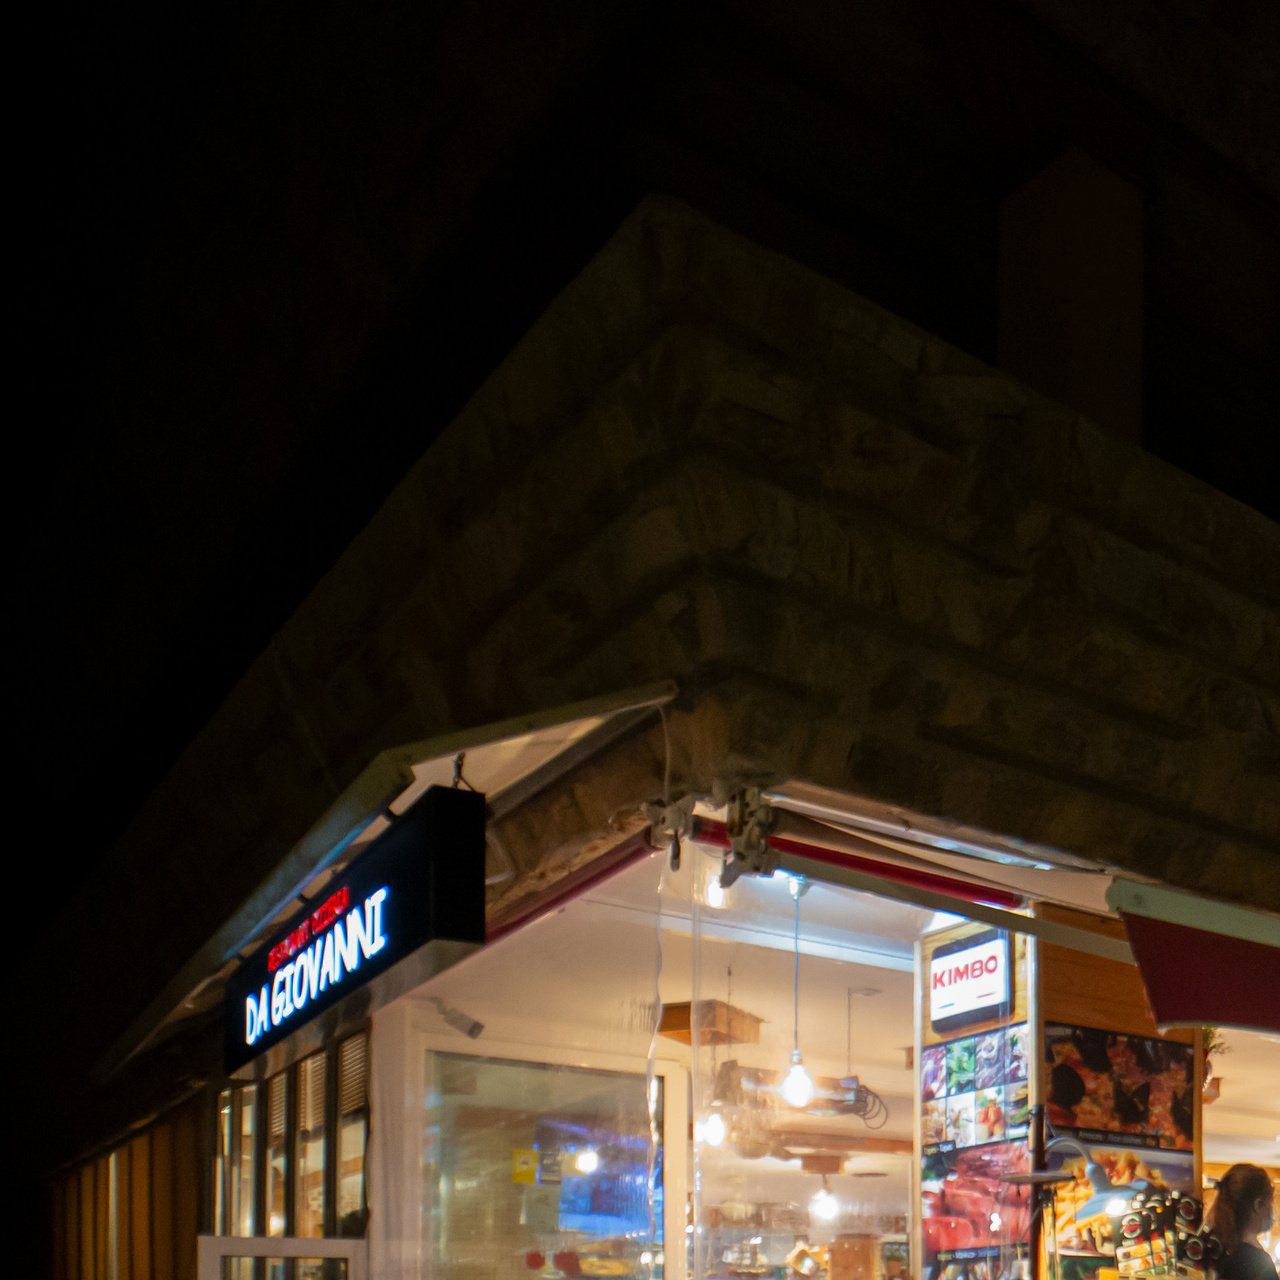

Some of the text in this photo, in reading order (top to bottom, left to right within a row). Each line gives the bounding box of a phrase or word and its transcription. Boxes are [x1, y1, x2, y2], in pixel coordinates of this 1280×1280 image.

[245, 885, 390, 1046] DA GIOVANNI
[932, 955, 998, 991] KIMBO
